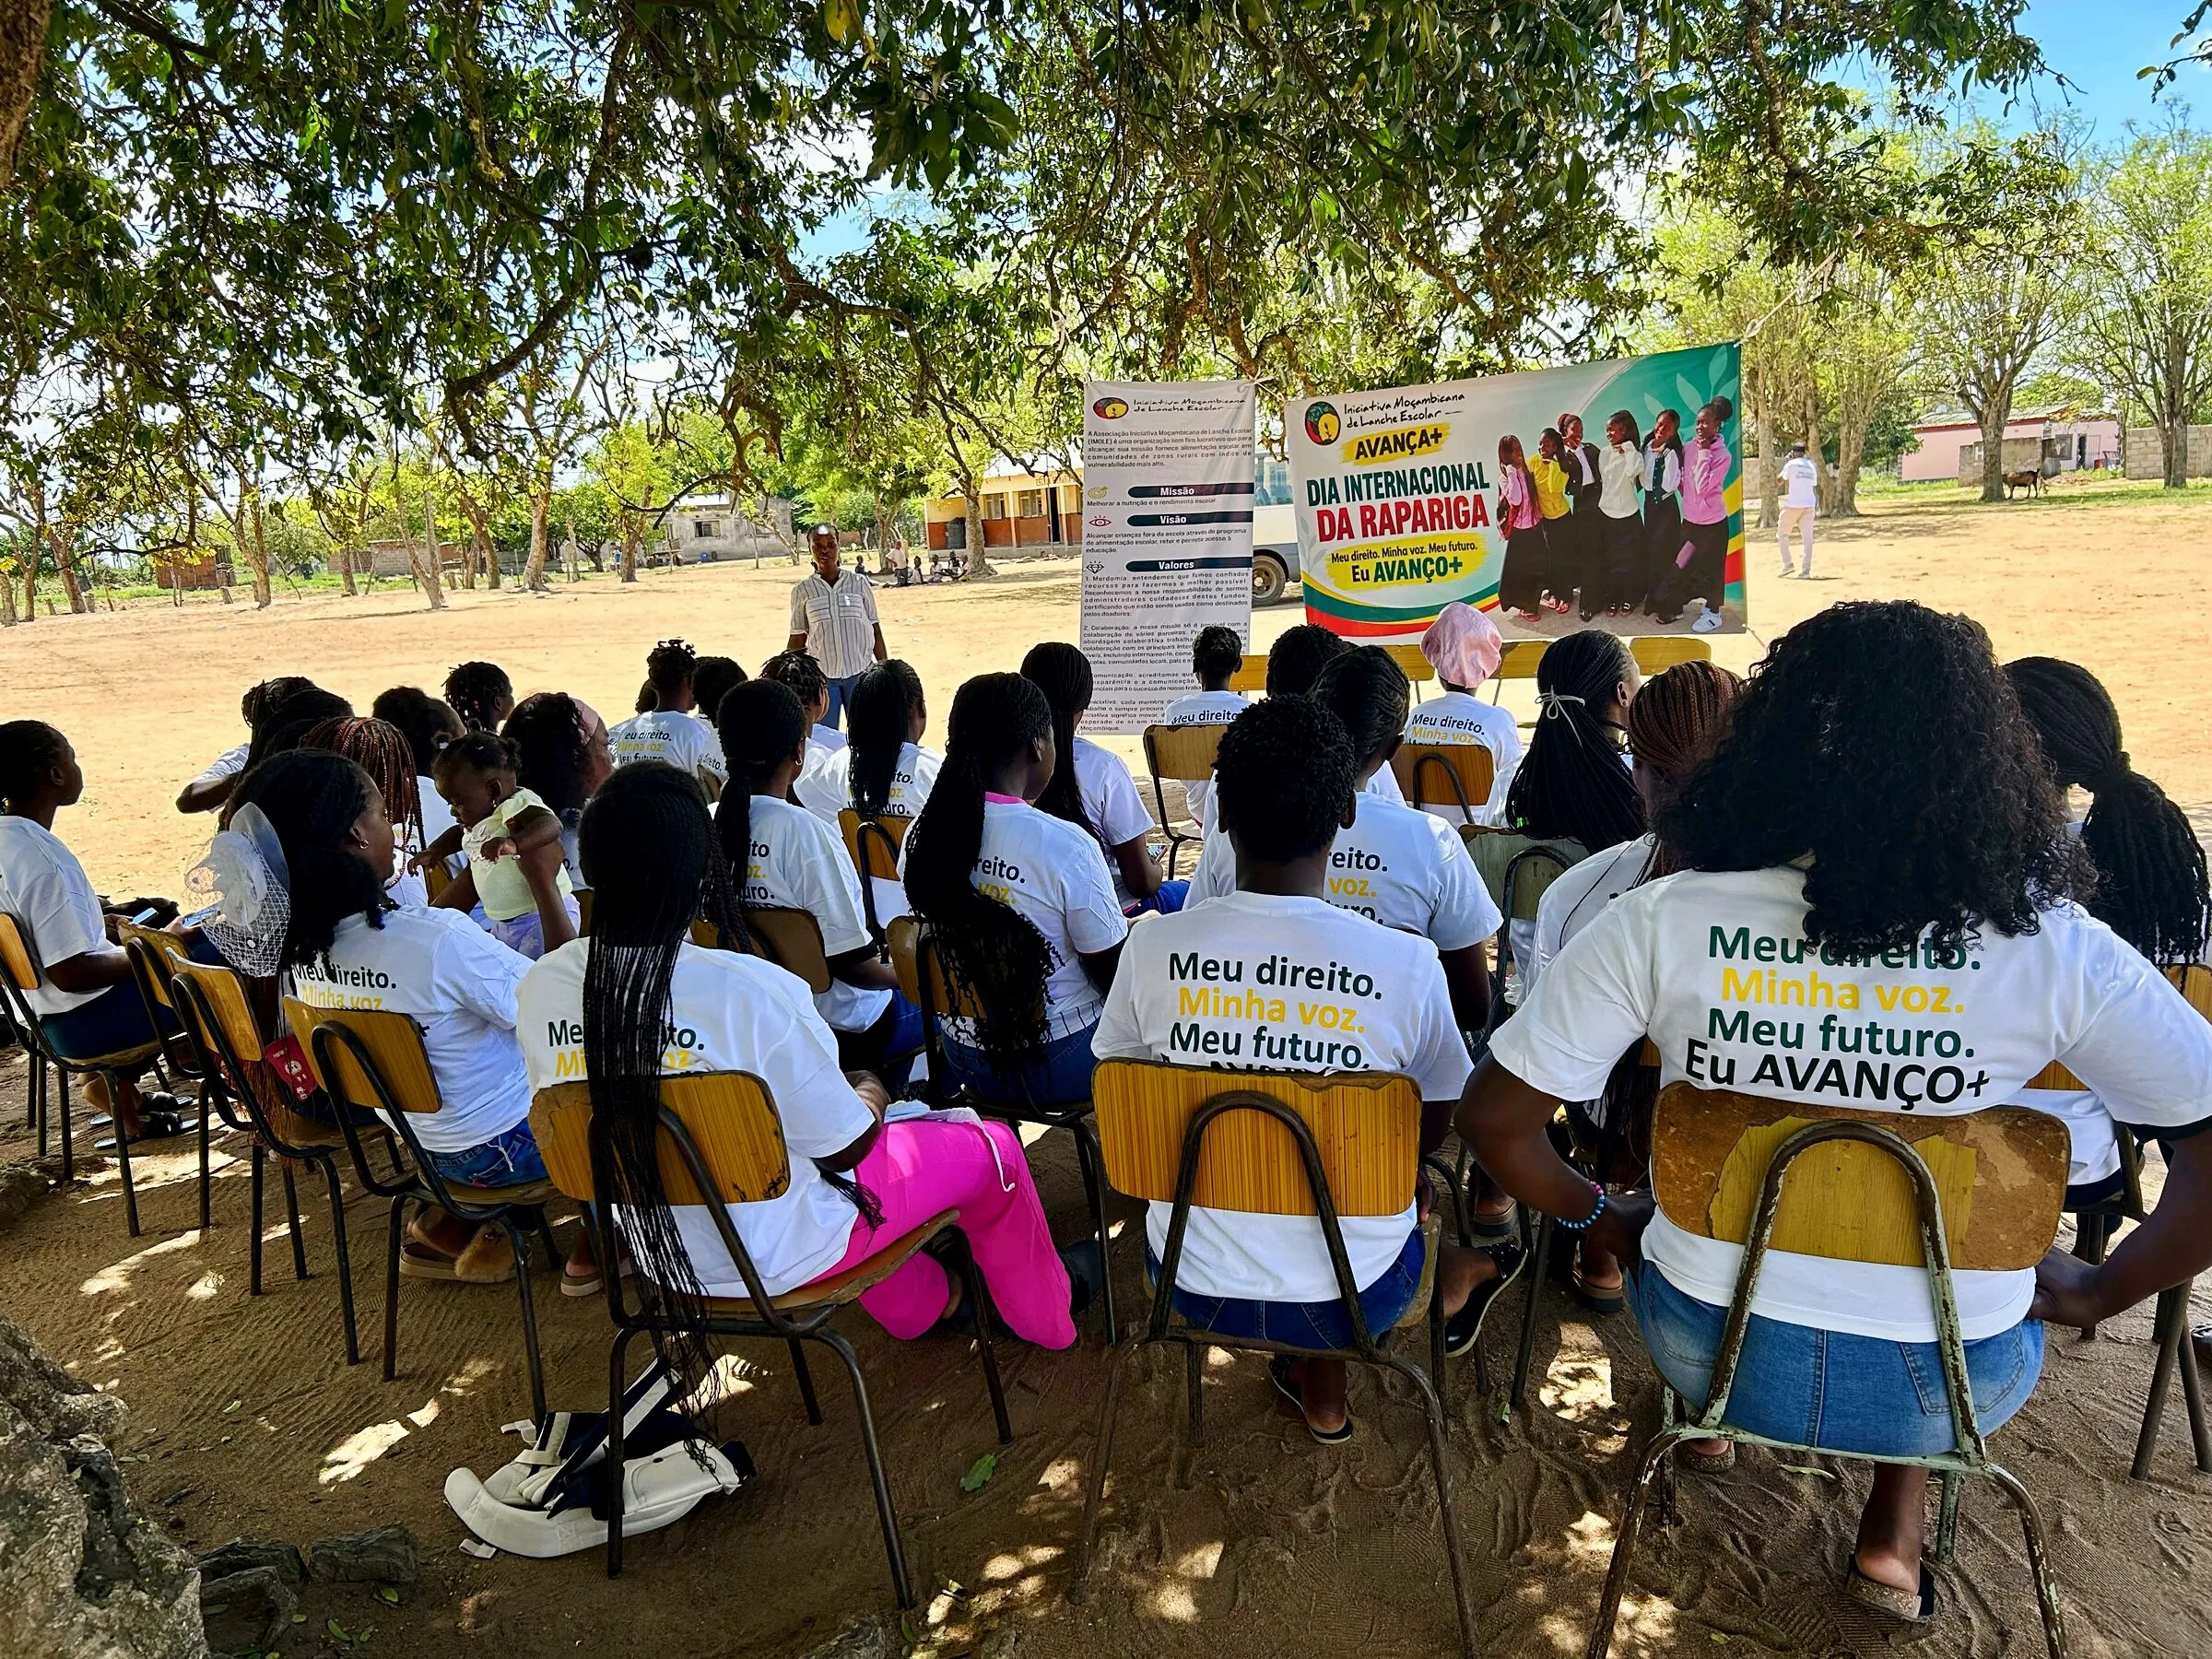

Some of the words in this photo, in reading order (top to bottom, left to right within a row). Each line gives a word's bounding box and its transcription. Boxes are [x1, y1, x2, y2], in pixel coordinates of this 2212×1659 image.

[1344, 400, 1392, 415] Iniciativa
[1394, 392, 1465, 409] Moçambicana
[1347, 416, 1359, 429] de
[1359, 411, 1399, 427] Lanche
[1400, 406, 1441, 422] Escolar
[1355, 427, 1442, 460] AVANÇA+
[1160, 487, 1195, 496] Missão
[1306, 476, 1341, 507] DIA
[1344, 462, 1490, 503] INTERNACIONAL
[1159, 515, 1187, 524] Visão
[1316, 506, 1355, 543] DA
[1359, 493, 1490, 538] RAPARIGA
[1331, 549, 1349, 563] Meu
[1350, 547, 1381, 562] direito.
[1382, 545, 1408, 559] Minha
[1409, 544, 1427, 555] voz.
[1429, 542, 1447, 553] Meu
[1448, 540, 1478, 553] futuro.
[1159, 561, 1194, 570] Valores
[1351, 564, 1371, 582] Eu
[1373, 555, 1463, 583] AVANÇO+
[624, 731, 637, 740] eu
[1411, 713, 1438, 726] Meu
[1440, 715, 1485, 735] direito.
[1411, 725, 1448, 741] Minha
[889, 788, 904, 798] oz.
[882, 803, 911, 815] uro.
[747, 864, 767, 879] oz.
[974, 855, 1026, 884] reito.
[1329, 847, 1388, 872] eito.
[745, 886, 775, 900] uro.
[977, 882, 1017, 904] voz.
[1328, 877, 1377, 898] voz.
[1708, 925, 1804, 964] Meu
[1169, 952, 1243, 982] Meu
[1255, 955, 1382, 1000] direito.
[301, 983, 345, 1008] Minha
[1722, 966, 1860, 1011] Minha
[1875, 983, 1964, 1015] voz.
[1179, 987, 1287, 1023] Minha
[1298, 1002, 1365, 1033] voz.
[547, 1019, 583, 1047] Me
[1170, 1021, 1242, 1056] Meu
[1253, 1025, 1371, 1069] futuro.
[1708, 1007, 1805, 1052] Meu
[1819, 1014, 1976, 1059] futuro.
[1686, 1038, 1735, 1085] Eu
[1750, 1053, 1990, 1111] AVANÇO+
